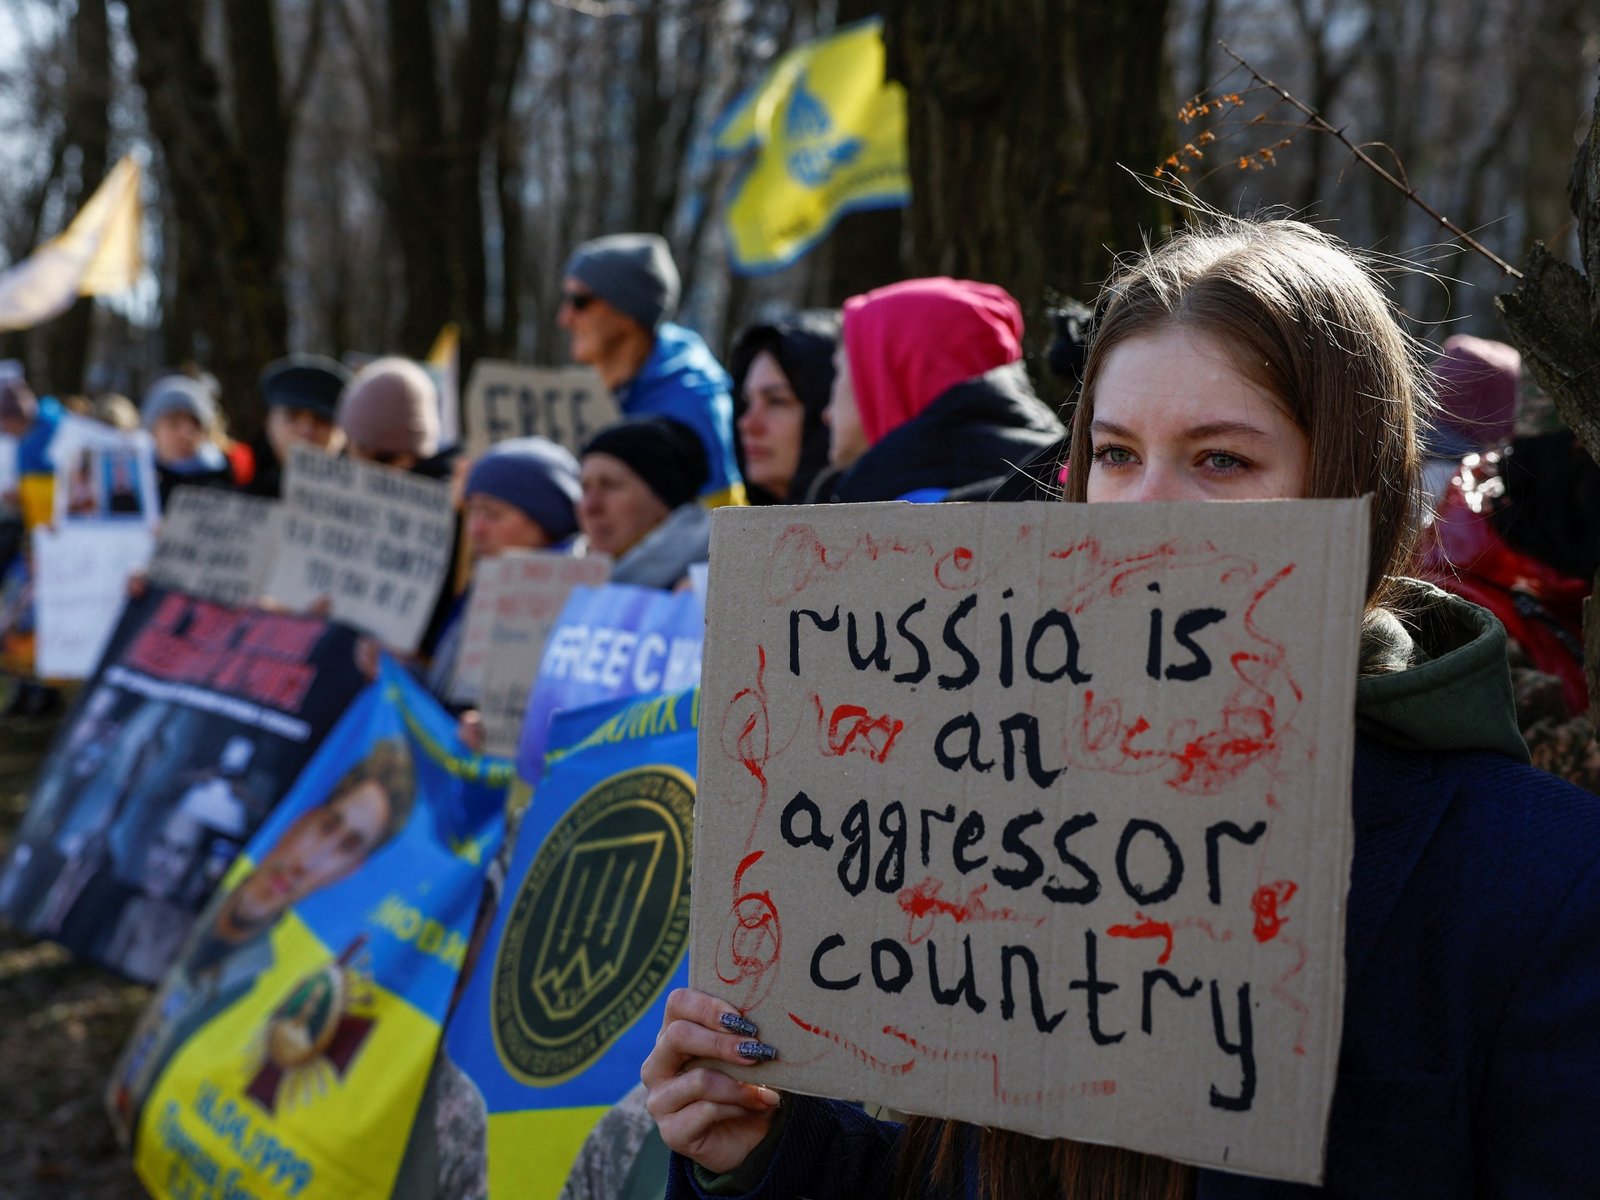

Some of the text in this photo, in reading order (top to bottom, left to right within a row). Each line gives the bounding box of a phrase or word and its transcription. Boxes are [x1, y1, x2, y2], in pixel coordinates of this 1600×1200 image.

[542, 624, 640, 690] FREE
[788, 587, 1093, 691] russia
[1145, 582, 1227, 682] is
[933, 711, 1066, 789] an
[780, 790, 1267, 906] aggressor
[809, 928, 1257, 1113] country
